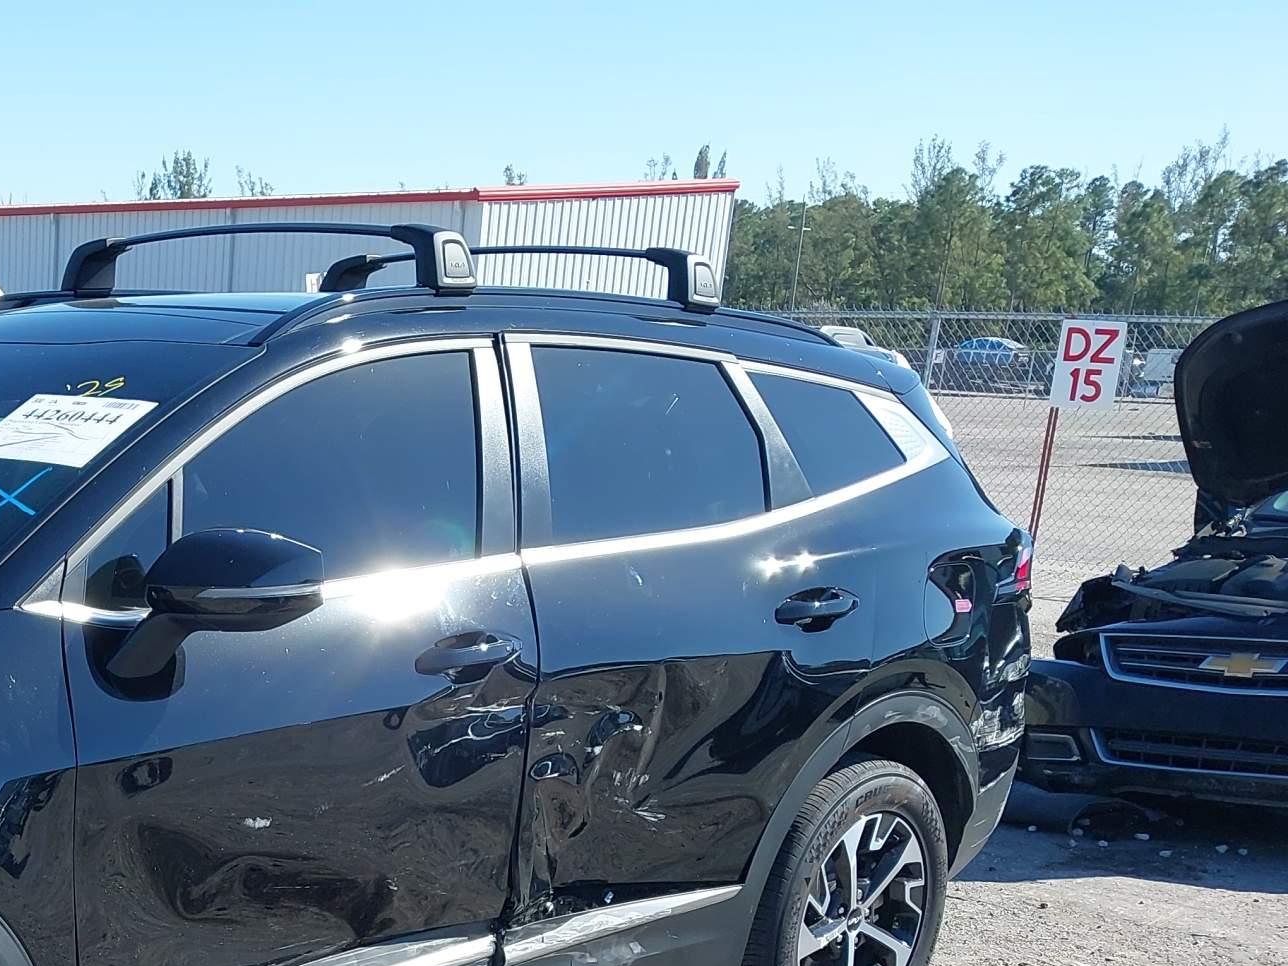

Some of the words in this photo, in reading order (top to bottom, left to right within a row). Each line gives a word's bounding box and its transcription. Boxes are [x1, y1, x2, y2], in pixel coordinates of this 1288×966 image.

[1063, 327, 1120, 364] DZ
[1069, 368, 1103, 402] 15
[22, 408, 125, 425] 44260444
